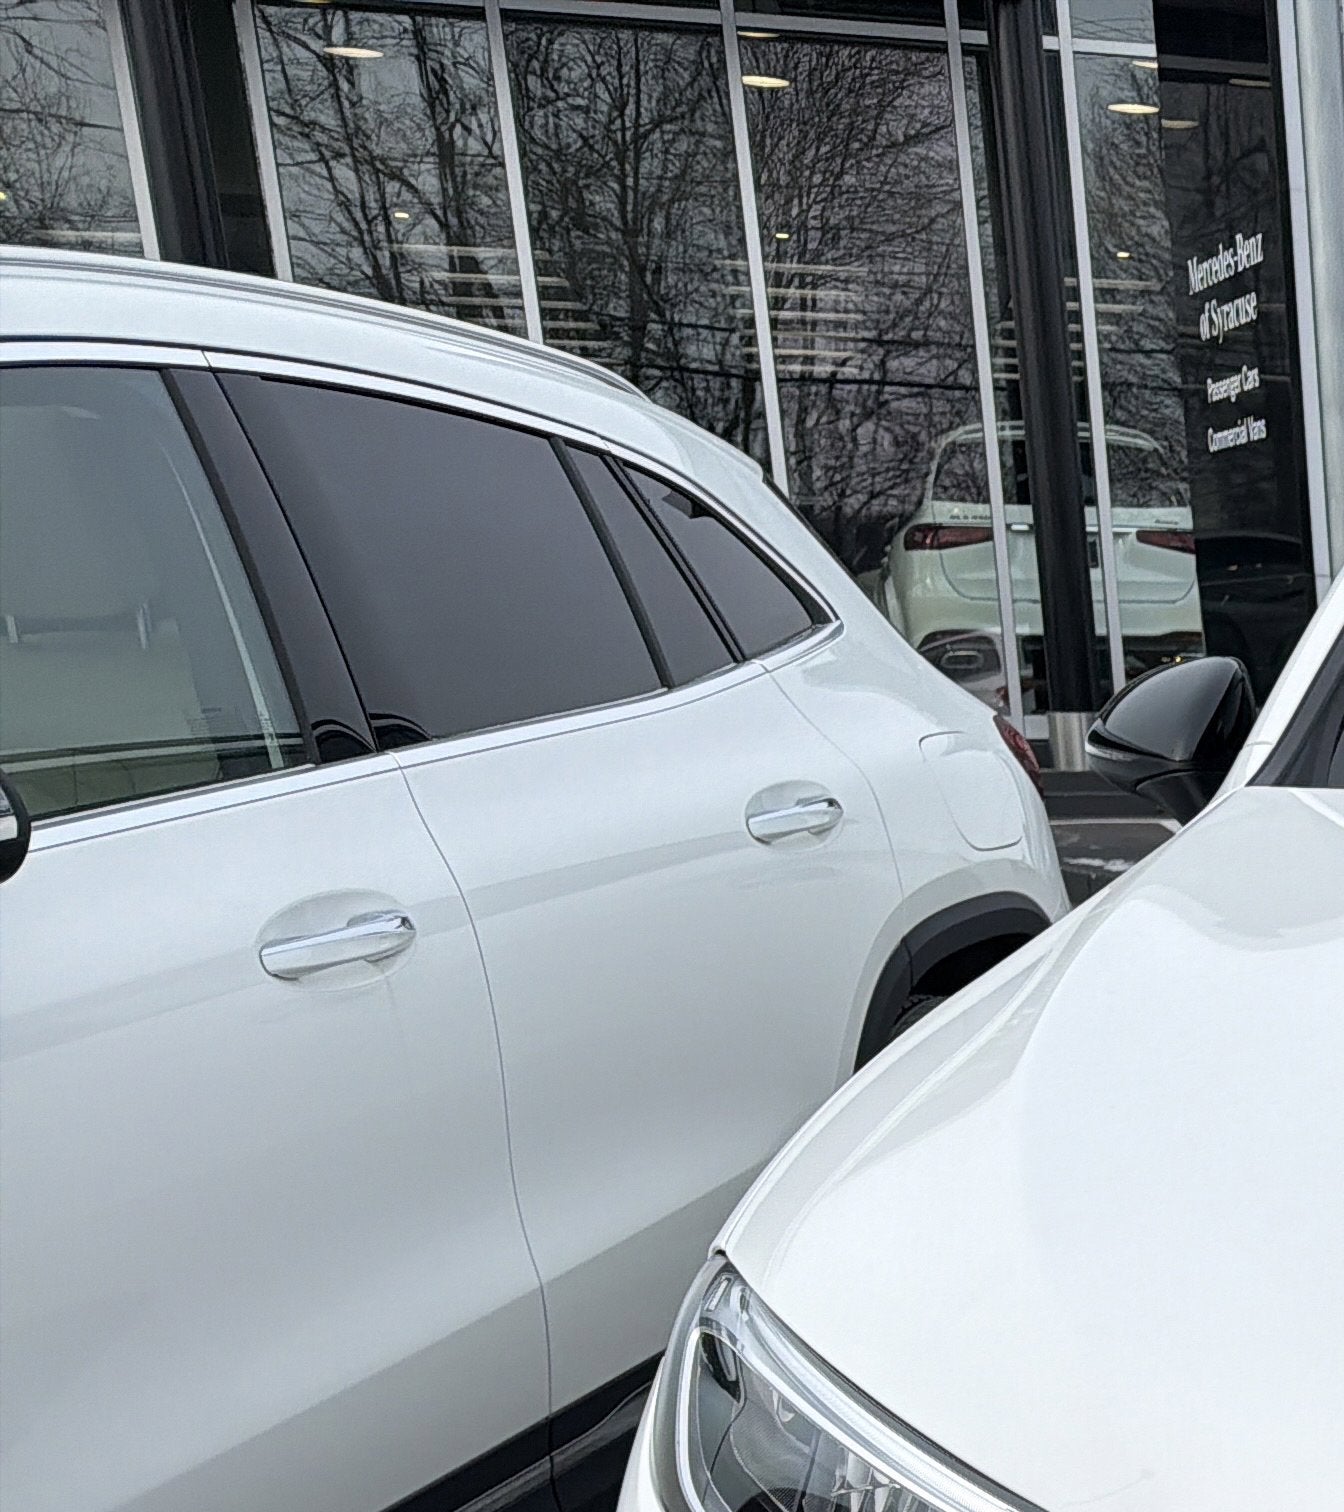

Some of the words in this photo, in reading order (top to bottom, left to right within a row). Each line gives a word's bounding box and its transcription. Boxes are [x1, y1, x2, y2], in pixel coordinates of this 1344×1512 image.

[1188, 233, 1263, 295] Mercedes-Benz
[1199, 302, 1211, 342] of
[1211, 291, 1257, 343] Syracuse
